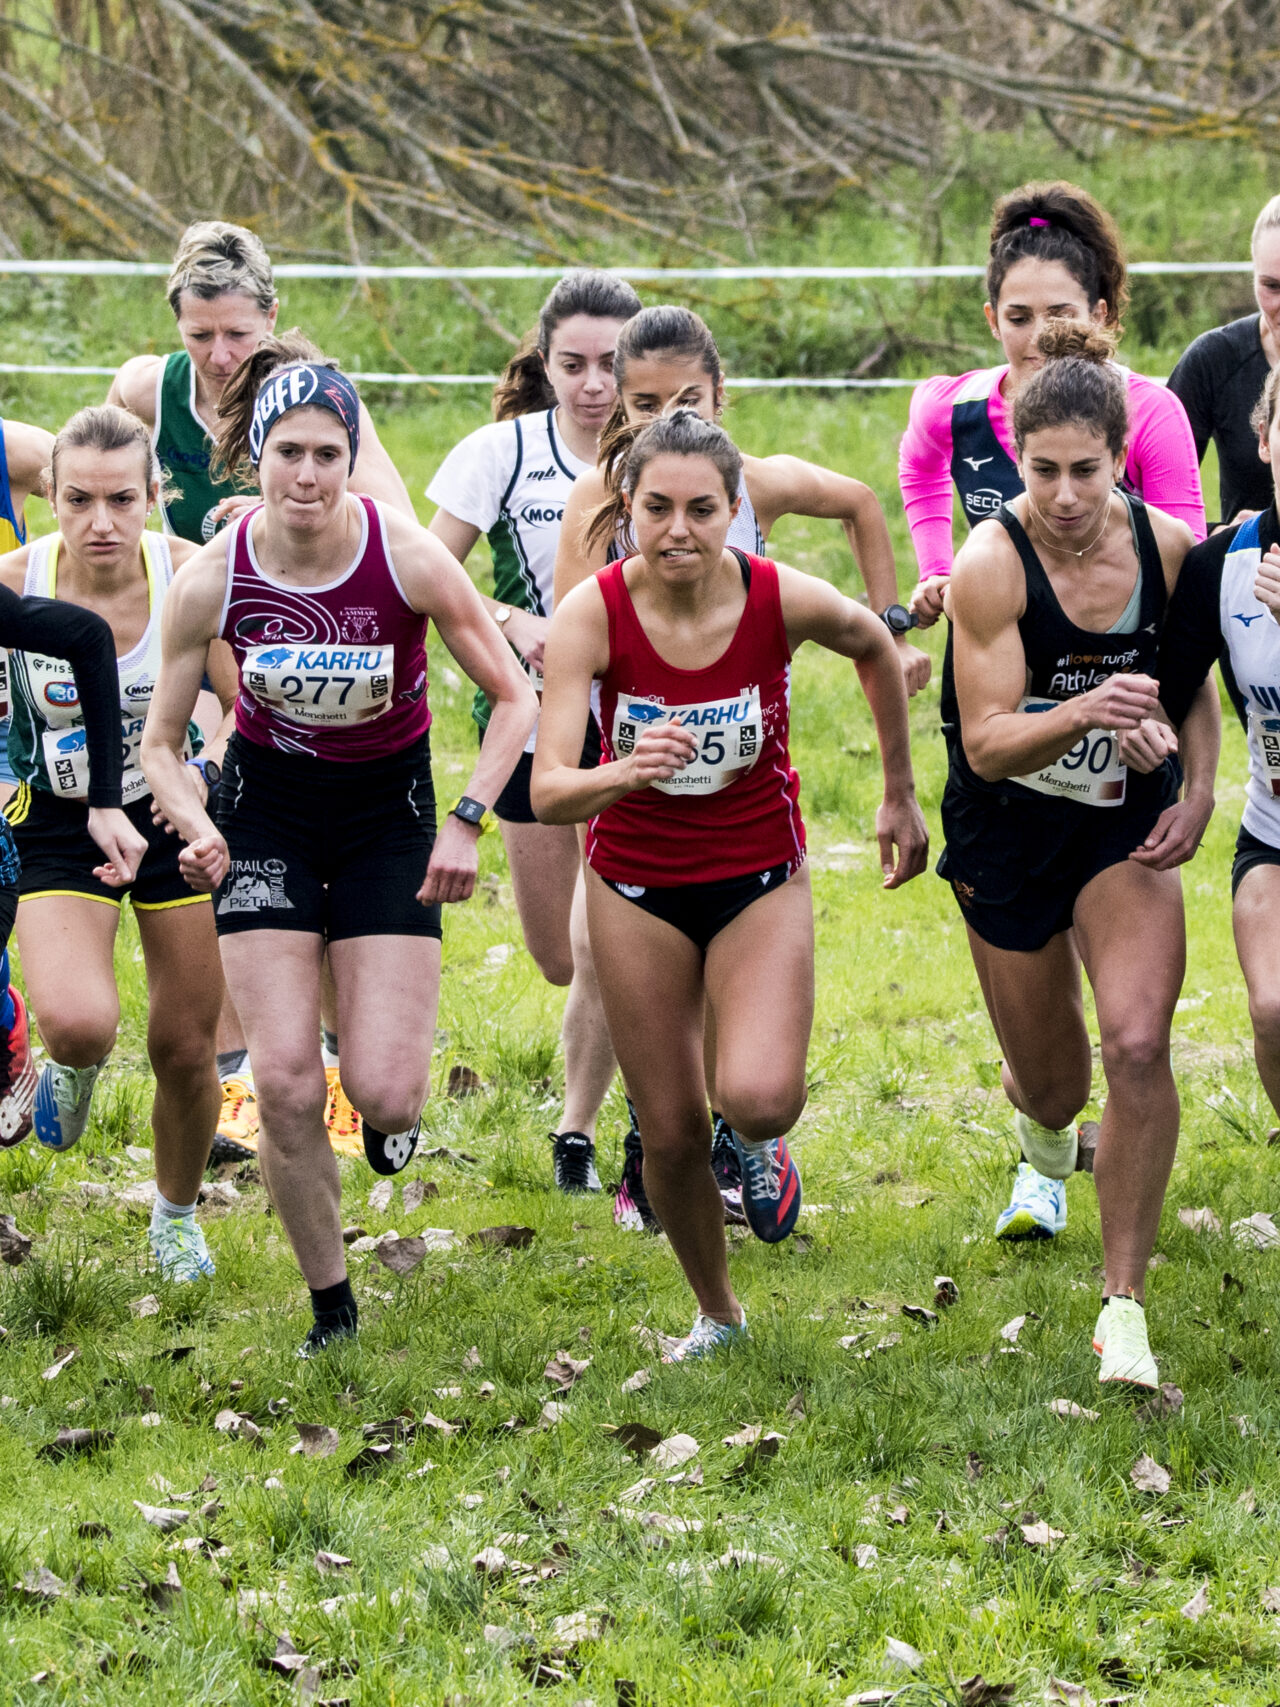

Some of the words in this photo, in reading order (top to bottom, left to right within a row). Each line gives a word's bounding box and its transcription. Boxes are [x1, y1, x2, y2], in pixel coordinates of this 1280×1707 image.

[965, 492, 1002, 509] SECO
[296, 650, 383, 671] KARHU
[281, 675, 356, 706] 277
[295, 707, 347, 721] Menchetti
[1038, 772, 1091, 794] Menchetti
[230, 860, 264, 873] TRAIL
